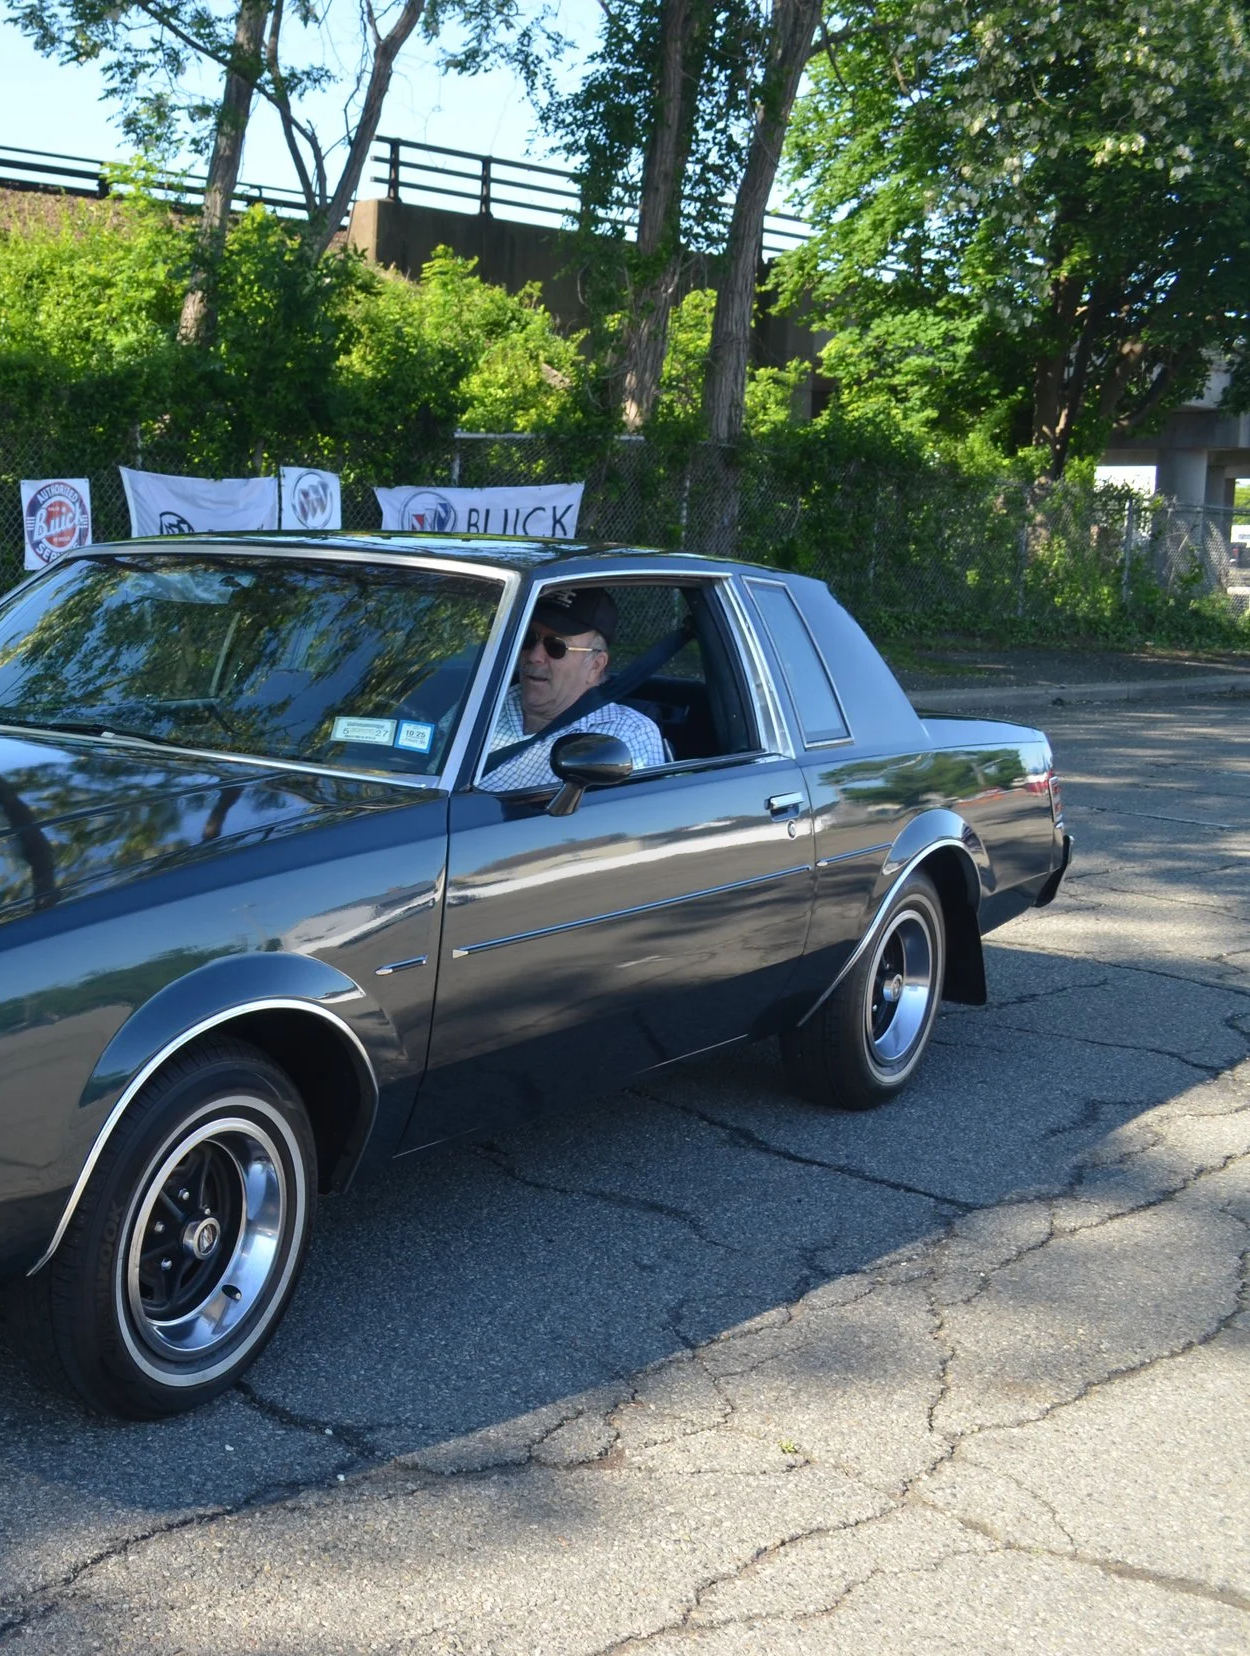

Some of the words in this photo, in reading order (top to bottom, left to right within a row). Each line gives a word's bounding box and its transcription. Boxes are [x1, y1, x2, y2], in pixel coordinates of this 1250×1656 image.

[34, 502, 84, 541] Buick
[467, 504, 574, 537] BUICK
[375, 729, 389, 737] 27
